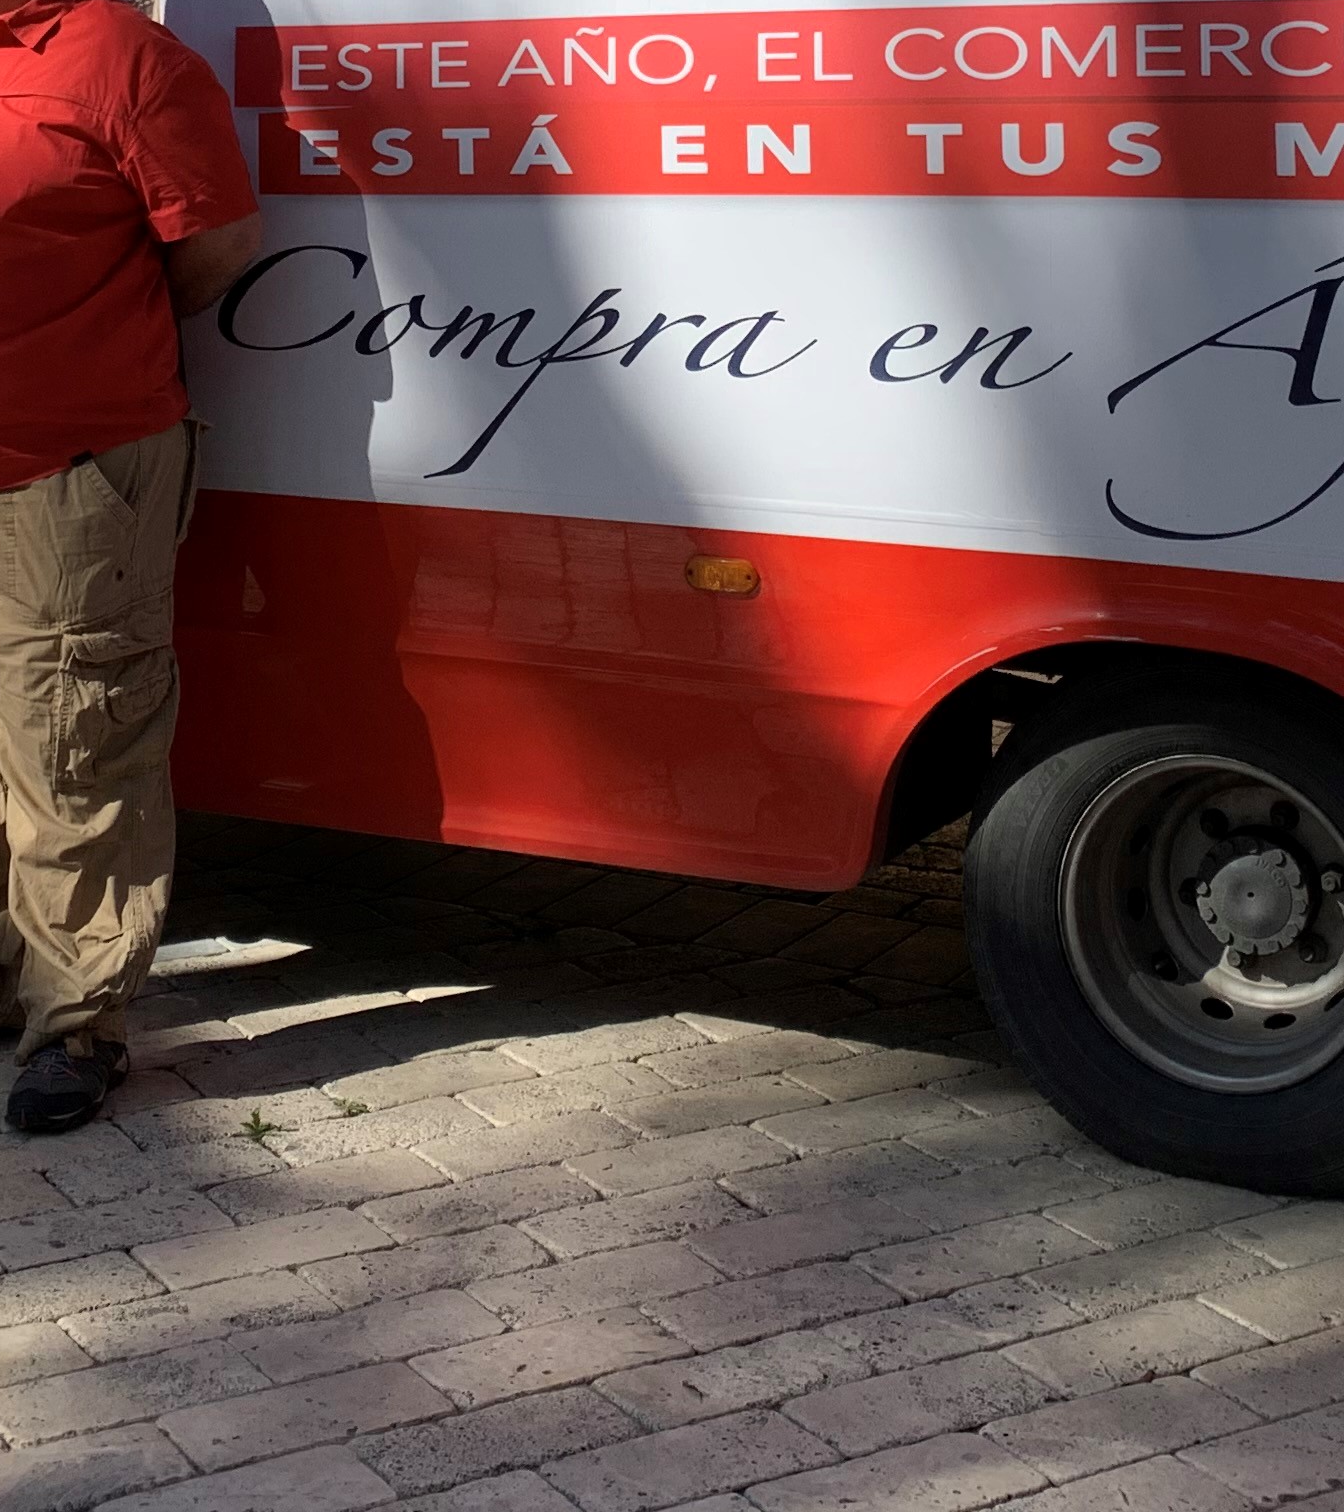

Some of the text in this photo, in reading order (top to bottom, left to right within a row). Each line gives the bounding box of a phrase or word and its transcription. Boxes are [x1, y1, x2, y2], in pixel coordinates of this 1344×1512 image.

[291, 40, 472, 92] ESTE
[497, 26, 719, 93] AÑO,
[757, 30, 854, 83] EL
[298, 114, 573, 177] ESTÁ
[661, 123, 812, 175] EN
[906, 120, 1162, 177] TUS
[216, 244, 818, 479] Compra
[870, 324, 1073, 390] en
